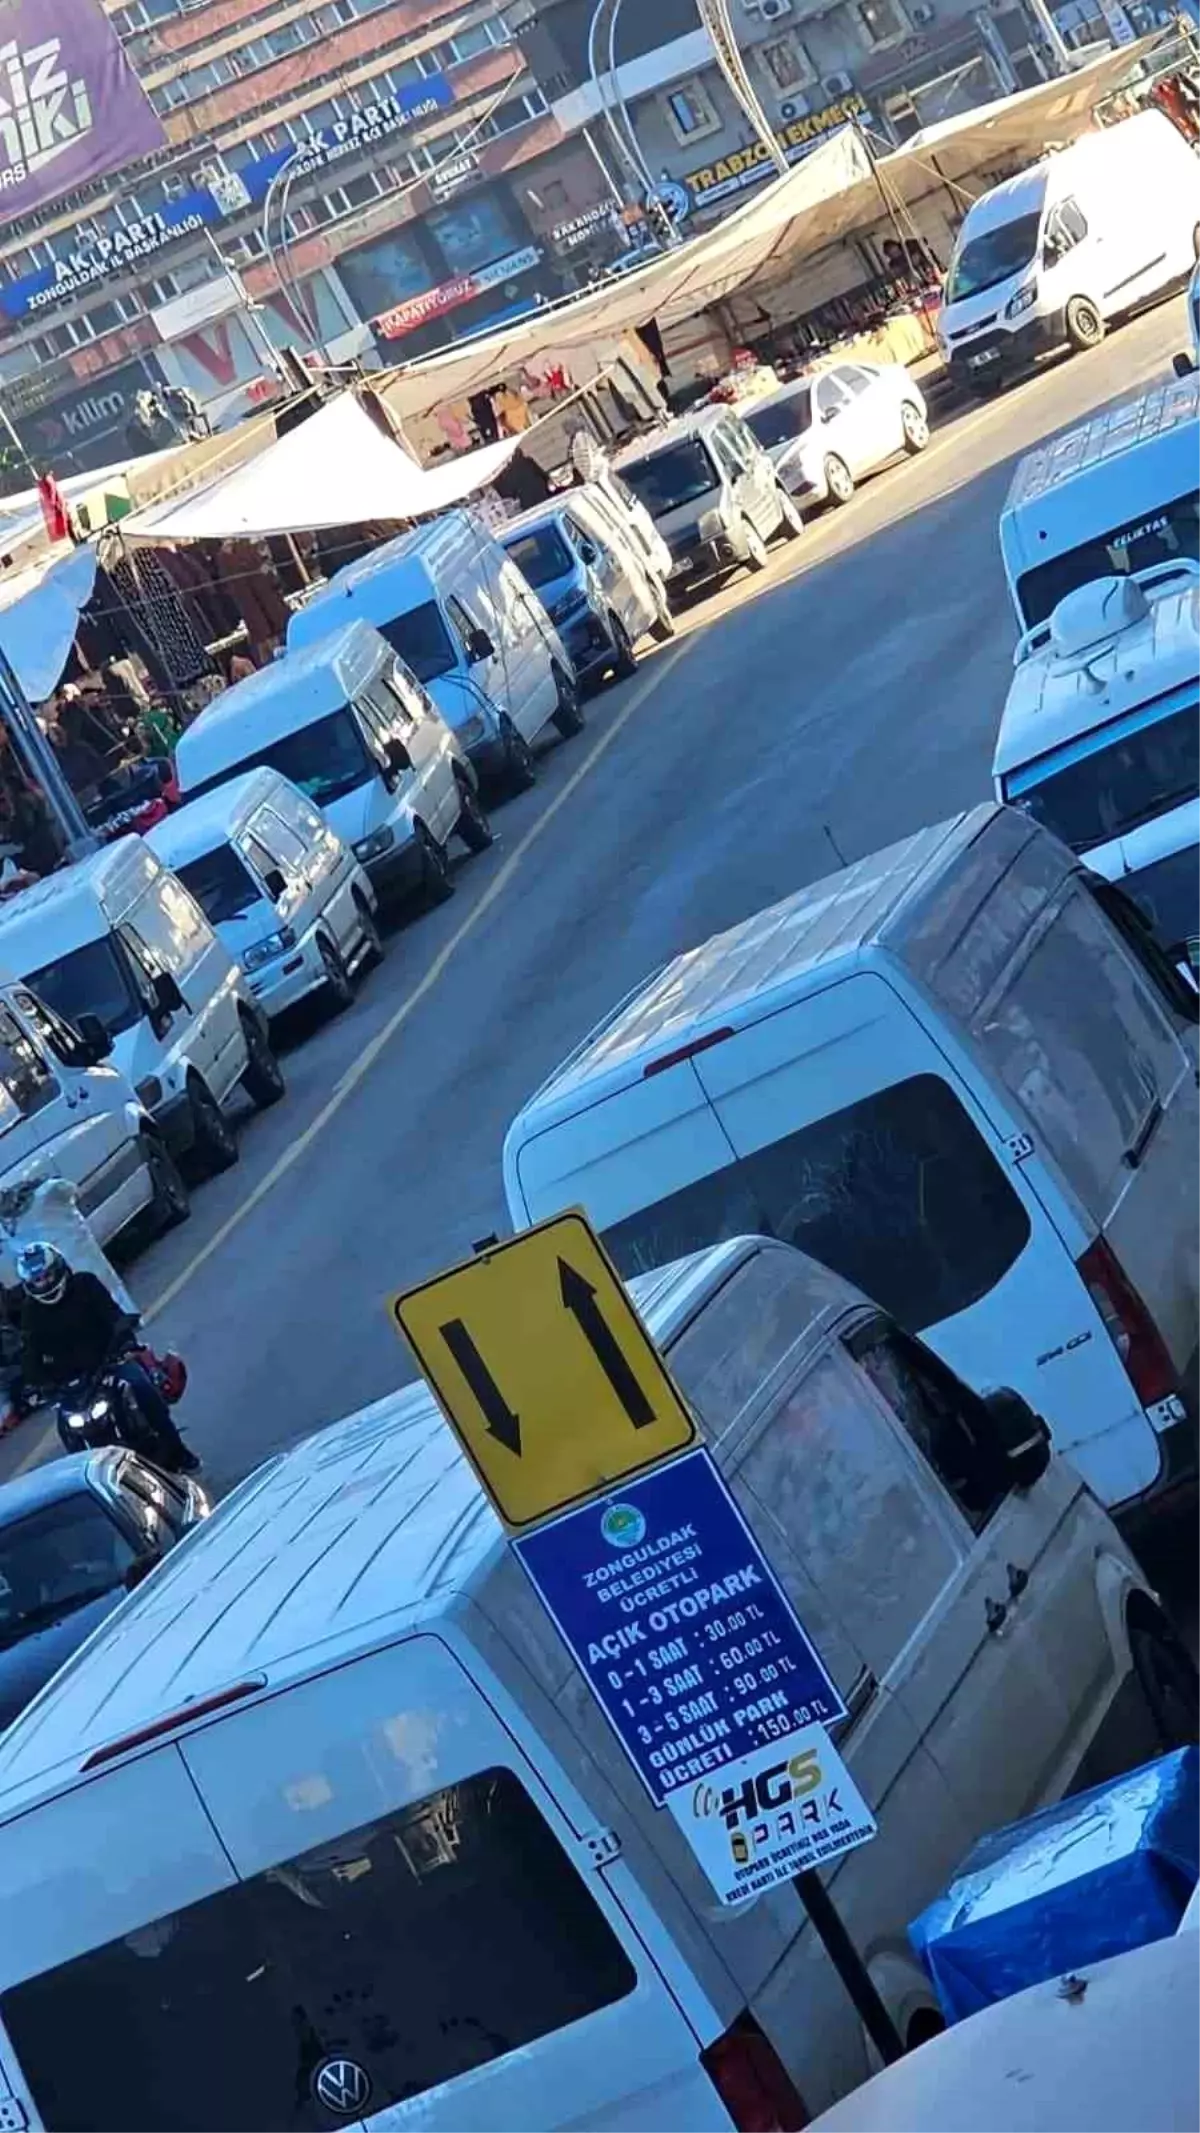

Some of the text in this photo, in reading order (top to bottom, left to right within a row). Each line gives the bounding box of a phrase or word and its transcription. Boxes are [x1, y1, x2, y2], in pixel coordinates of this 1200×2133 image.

[27, 262, 108, 309] ZONGULDAK
[55, 251, 90, 281] AK
[584, 1524, 696, 1587] ZONGULDAK
[588, 1565, 760, 1664] AÇIK OTOPARK
[620, 1568, 698, 1612] ÜCRETLİ
[648, 1638, 688, 1669] SAAT
[745, 1604, 764, 1620] TL
[663, 1664, 703, 1696] SAAT
[762, 1631, 781, 1646] TL
[678, 1692, 718, 1723] SAAT
[778, 1656, 796, 1672] TL
[810, 1700, 828, 1715] TL
[649, 1690, 788, 1767] GÜNLÜK PARK
[720, 1748, 822, 1829] HGS
[754, 1788, 842, 1844] PARK
